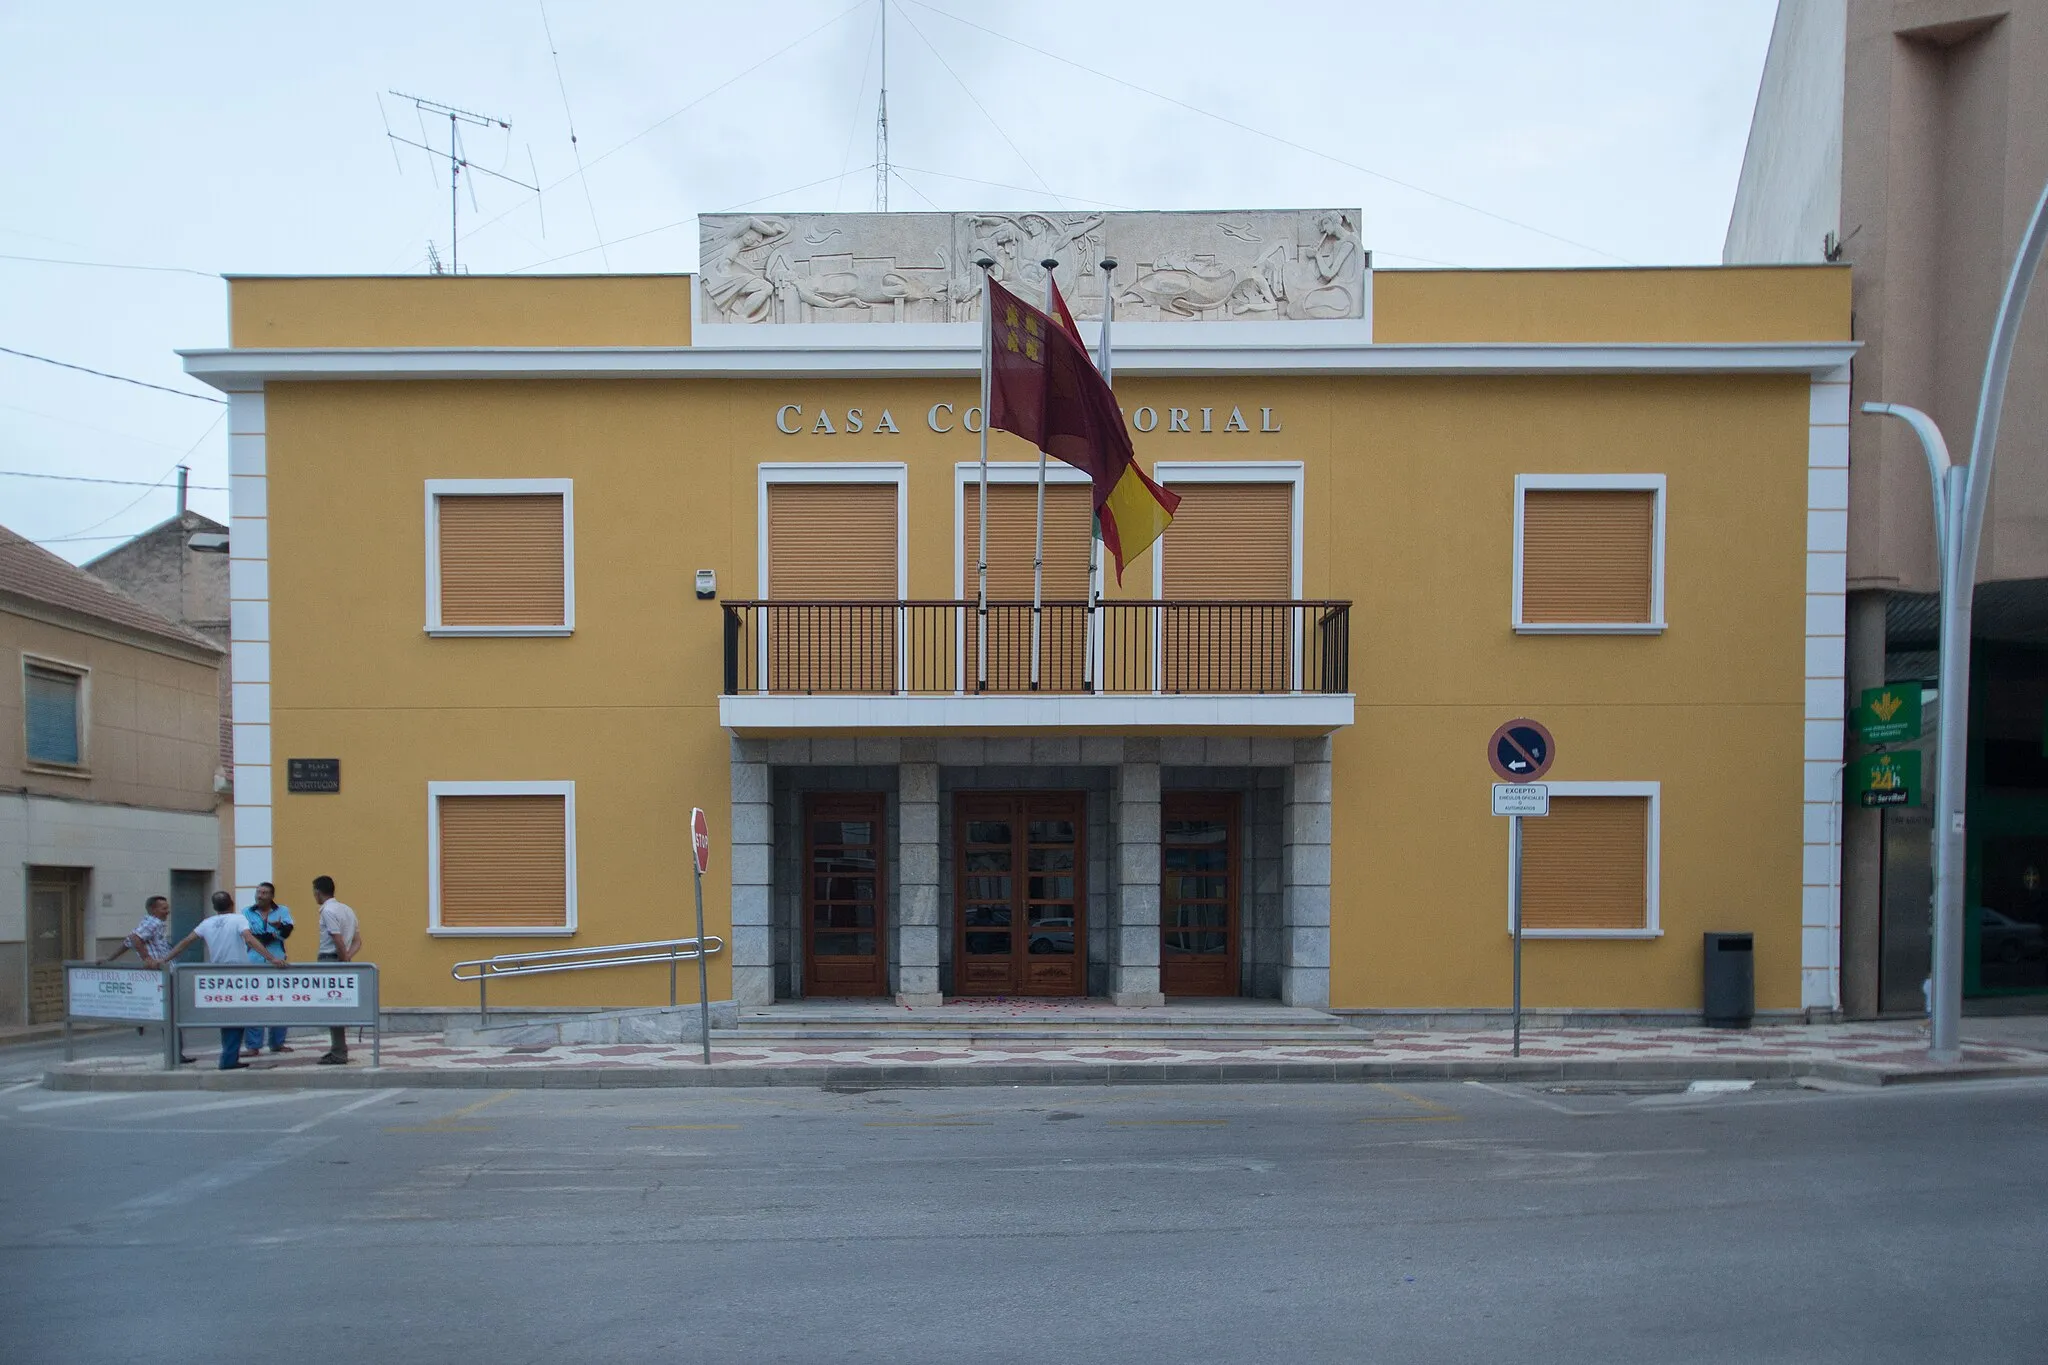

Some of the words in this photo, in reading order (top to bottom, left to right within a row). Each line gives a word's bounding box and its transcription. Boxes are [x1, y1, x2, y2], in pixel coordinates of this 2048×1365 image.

[776, 404, 900, 434] CASA
[927, 403, 1282, 433] COORIAL
[695, 832, 708, 849] STOP
[98, 981, 133, 994] CERES
[199, 977, 260, 990] ESPACIO
[266, 977, 354, 989] DISPONIBLE
[203, 994, 234, 1003] 968
[239, 994, 259, 1003] 46
[265, 994, 284, 1003] 41
[291, 994, 311, 1003] 96
